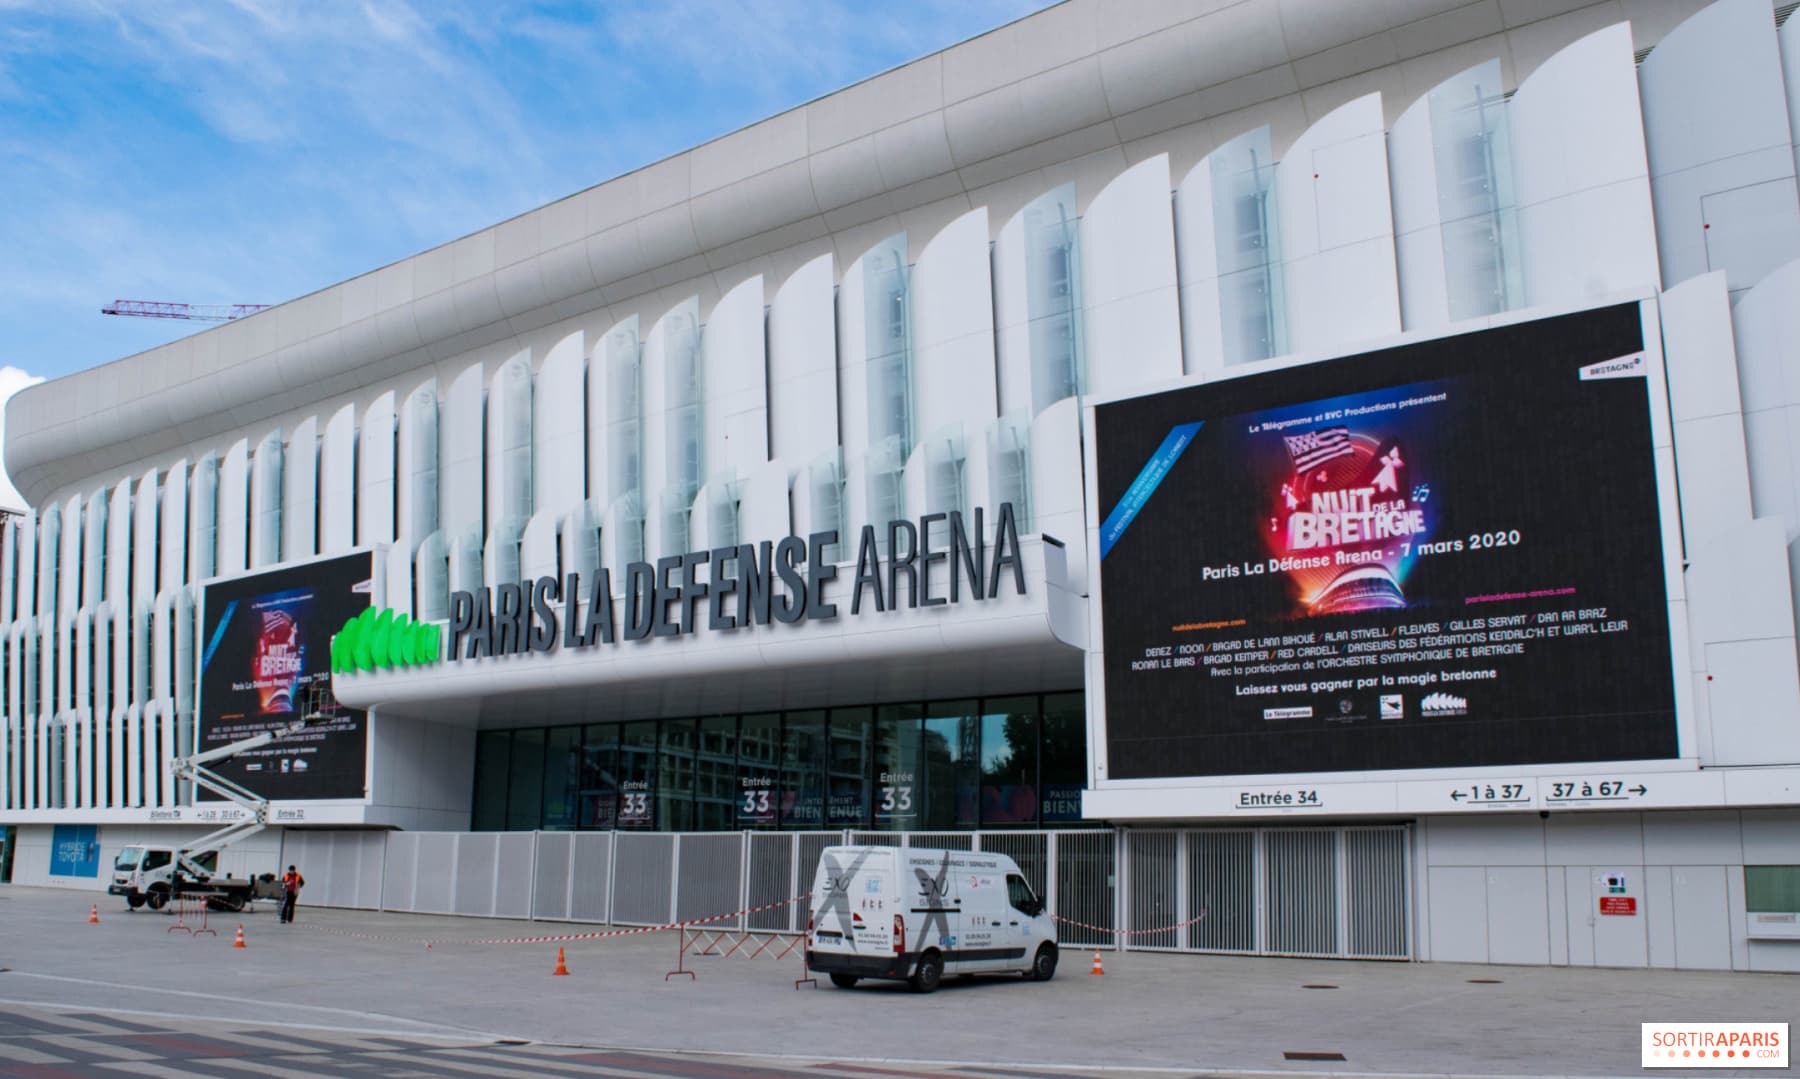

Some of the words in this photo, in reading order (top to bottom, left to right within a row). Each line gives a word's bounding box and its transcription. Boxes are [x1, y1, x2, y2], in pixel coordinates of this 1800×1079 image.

[1249, 423, 1260, 433] Le
[1261, 415, 1313, 431] Télégramme
[1315, 413, 1323, 422] et
[1344, 401, 1397, 417] Productions
[1399, 392, 1447, 409] présentent
[1373, 502, 1388, 513] DE
[1390, 499, 1406, 511] LA
[1288, 509, 1426, 550] BRETAGNE
[1202, 563, 1240, 581] Paris
[1244, 561, 1264, 576] La
[1269, 555, 1330, 573] Défense
[1335, 550, 1382, 565] Arena
[1401, 543, 1412, 557] 7
[1418, 538, 1463, 556] mars
[1469, 529, 1521, 550] 2020
[447, 575, 558, 662] PARIS
[564, 566, 615, 649] LA
[624, 530, 838, 641] DEFENSE
[851, 501, 1027, 616] ARENA
[1145, 646, 1171, 657] DENEZ
[1179, 643, 1205, 655] NOON
[1212, 639, 1242, 652] BAGAD
[1244, 638, 1256, 649] DE
[1258, 635, 1281, 648] LANN
[1324, 630, 1349, 642] ALAN
[1351, 627, 1389, 640] STIVELL
[1398, 622, 1440, 635] FLEUVES
[1450, 618, 1486, 631] GILLES
[1487, 615, 1528, 628] SERVAT
[1537, 611, 1559, 624] DAN
[1561, 609, 1576, 621] AR
[1578, 607, 1608, 620] BRAZ
[1132, 658, 1159, 670] RONAN
[1161, 658, 1171, 668] LE
[1173, 657, 1196, 667] BARS
[1203, 653, 1232, 665] BAGAD
[1235, 650, 1270, 663] KEMPER
[1277, 648, 1294, 660] RED
[1297, 645, 1339, 658] CARDELL
[1347, 638, 1396, 653] DANSEURS
[1398, 637, 1417, 650] DES
[1419, 631, 1486, 647] FÉDÉRATIONS
[1547, 625, 1560, 637] ET
[1601, 620, 1629, 633] LEUR
[1210, 667, 1232, 677] Avec
[1234, 665, 1243, 675] la
[1245, 661, 1300, 677] participation
[1302, 660, 1315, 671] de
[1380, 649, 1452, 664] SYMPHONIQUE
[1456, 647, 1469, 658] DE
[1472, 643, 1525, 657] BRETAGNE
[1235, 684, 1278, 696] Laissez
[1280, 682, 1307, 693] vous
[1311, 679, 1353, 694] gagner
[1357, 678, 1378, 690] par
[1382, 675, 1395, 686] la
[1398, 673, 1437, 687] magie
[1441, 669, 1497, 682] bretonne
[623, 780, 648, 790] Entrée
[742, 776, 771, 787] Entrée
[880, 772, 914, 783] Entrée
[1552, 783, 1574, 797] 37
[1581, 781, 1592, 796] à
[1599, 781, 1623, 796] 67
[623, 793, 647, 814] 33
[743, 790, 769, 813] 33
[881, 787, 912, 810] 33
[1240, 790, 1292, 806] Entrée
[1297, 790, 1318, 804] 34
[1471, 786, 1478, 800] 1
[1485, 784, 1495, 799] à
[1501, 784, 1524, 799] 37
[1043, 800, 1081, 814] BIEN
